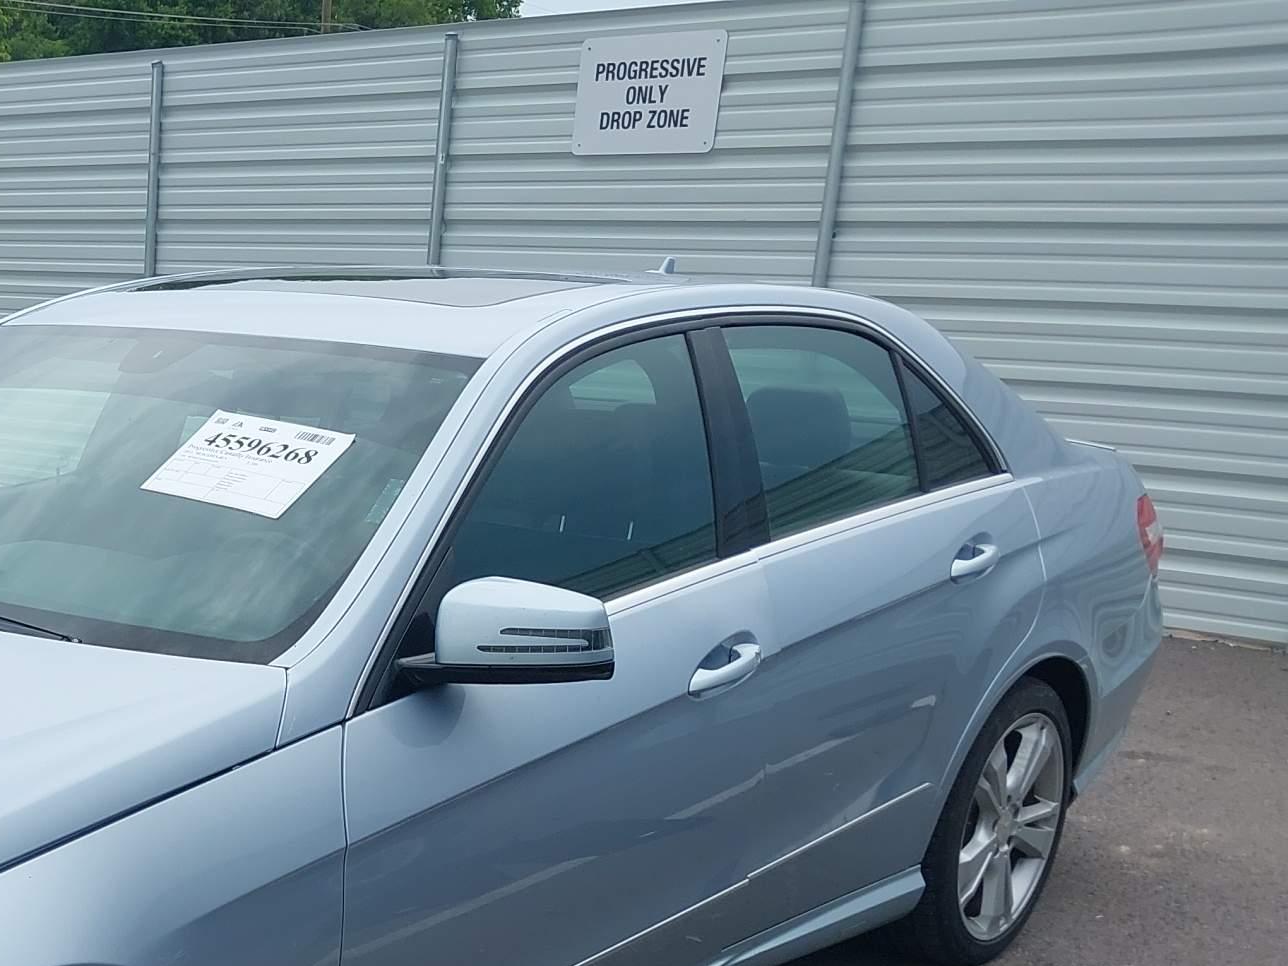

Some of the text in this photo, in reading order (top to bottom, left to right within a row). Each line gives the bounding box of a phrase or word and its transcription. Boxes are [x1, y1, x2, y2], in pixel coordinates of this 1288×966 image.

[595, 57, 707, 81] PROGRESSIVE
[626, 85, 669, 105] ONLY
[599, 109, 690, 130] DROP ZONE
[204, 431, 319, 465] 45596268
